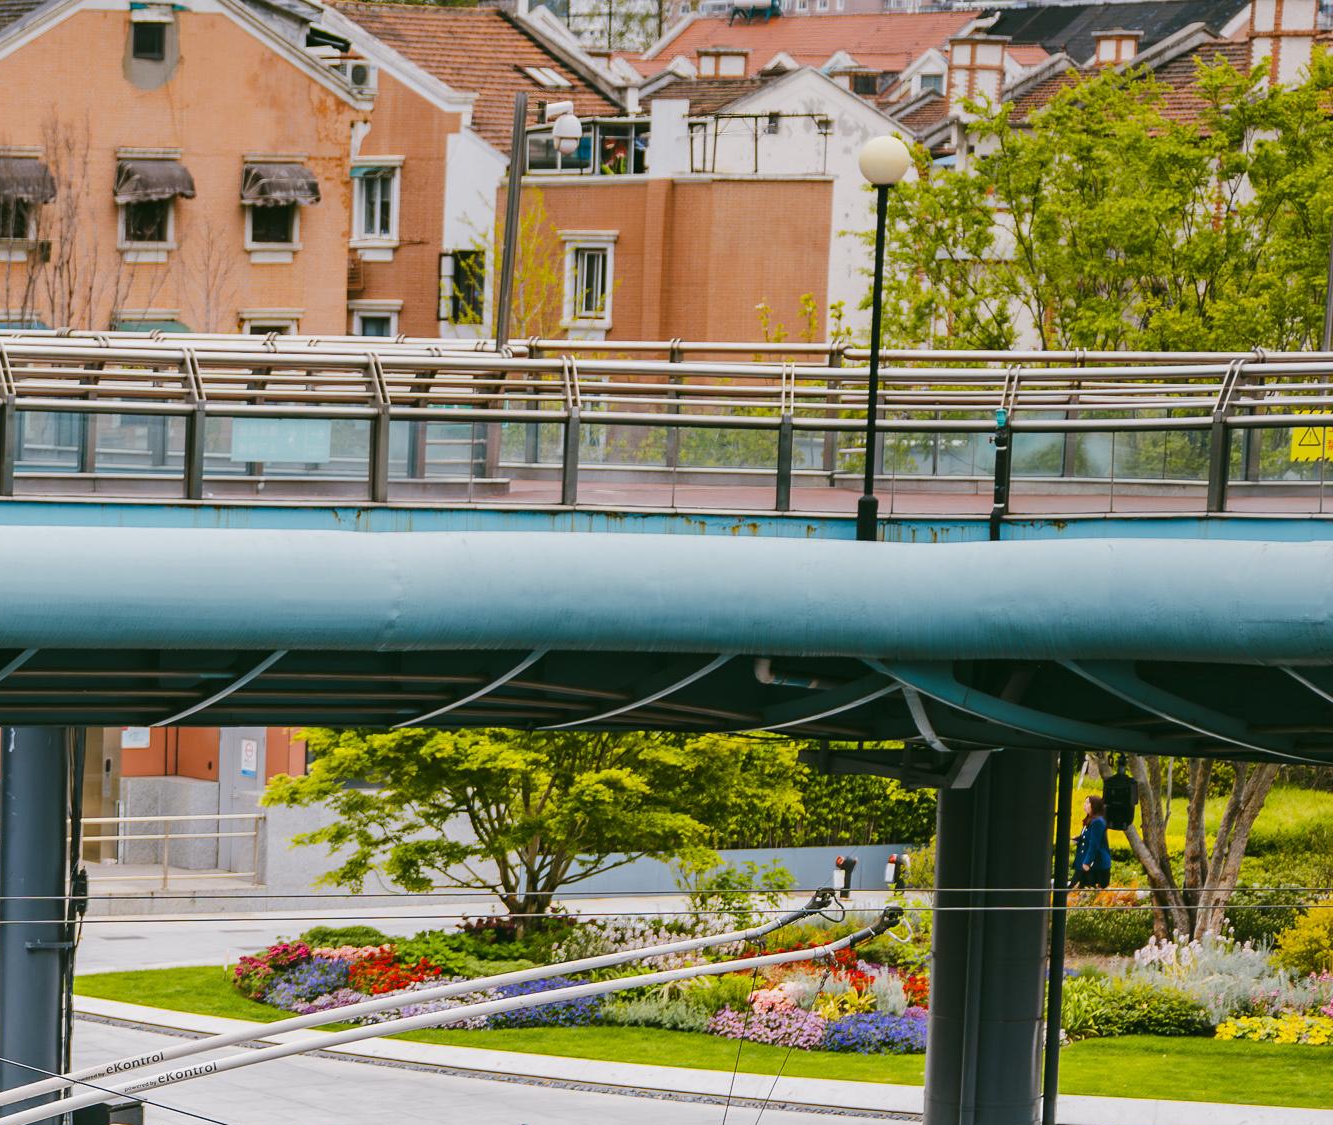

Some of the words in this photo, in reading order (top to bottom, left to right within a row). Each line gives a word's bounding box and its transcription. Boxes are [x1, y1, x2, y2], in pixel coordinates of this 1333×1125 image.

[106, 1051, 165, 1074] eKontrol
[124, 1081, 150, 1093] powered
[158, 1062, 218, 1084] eKontrol
